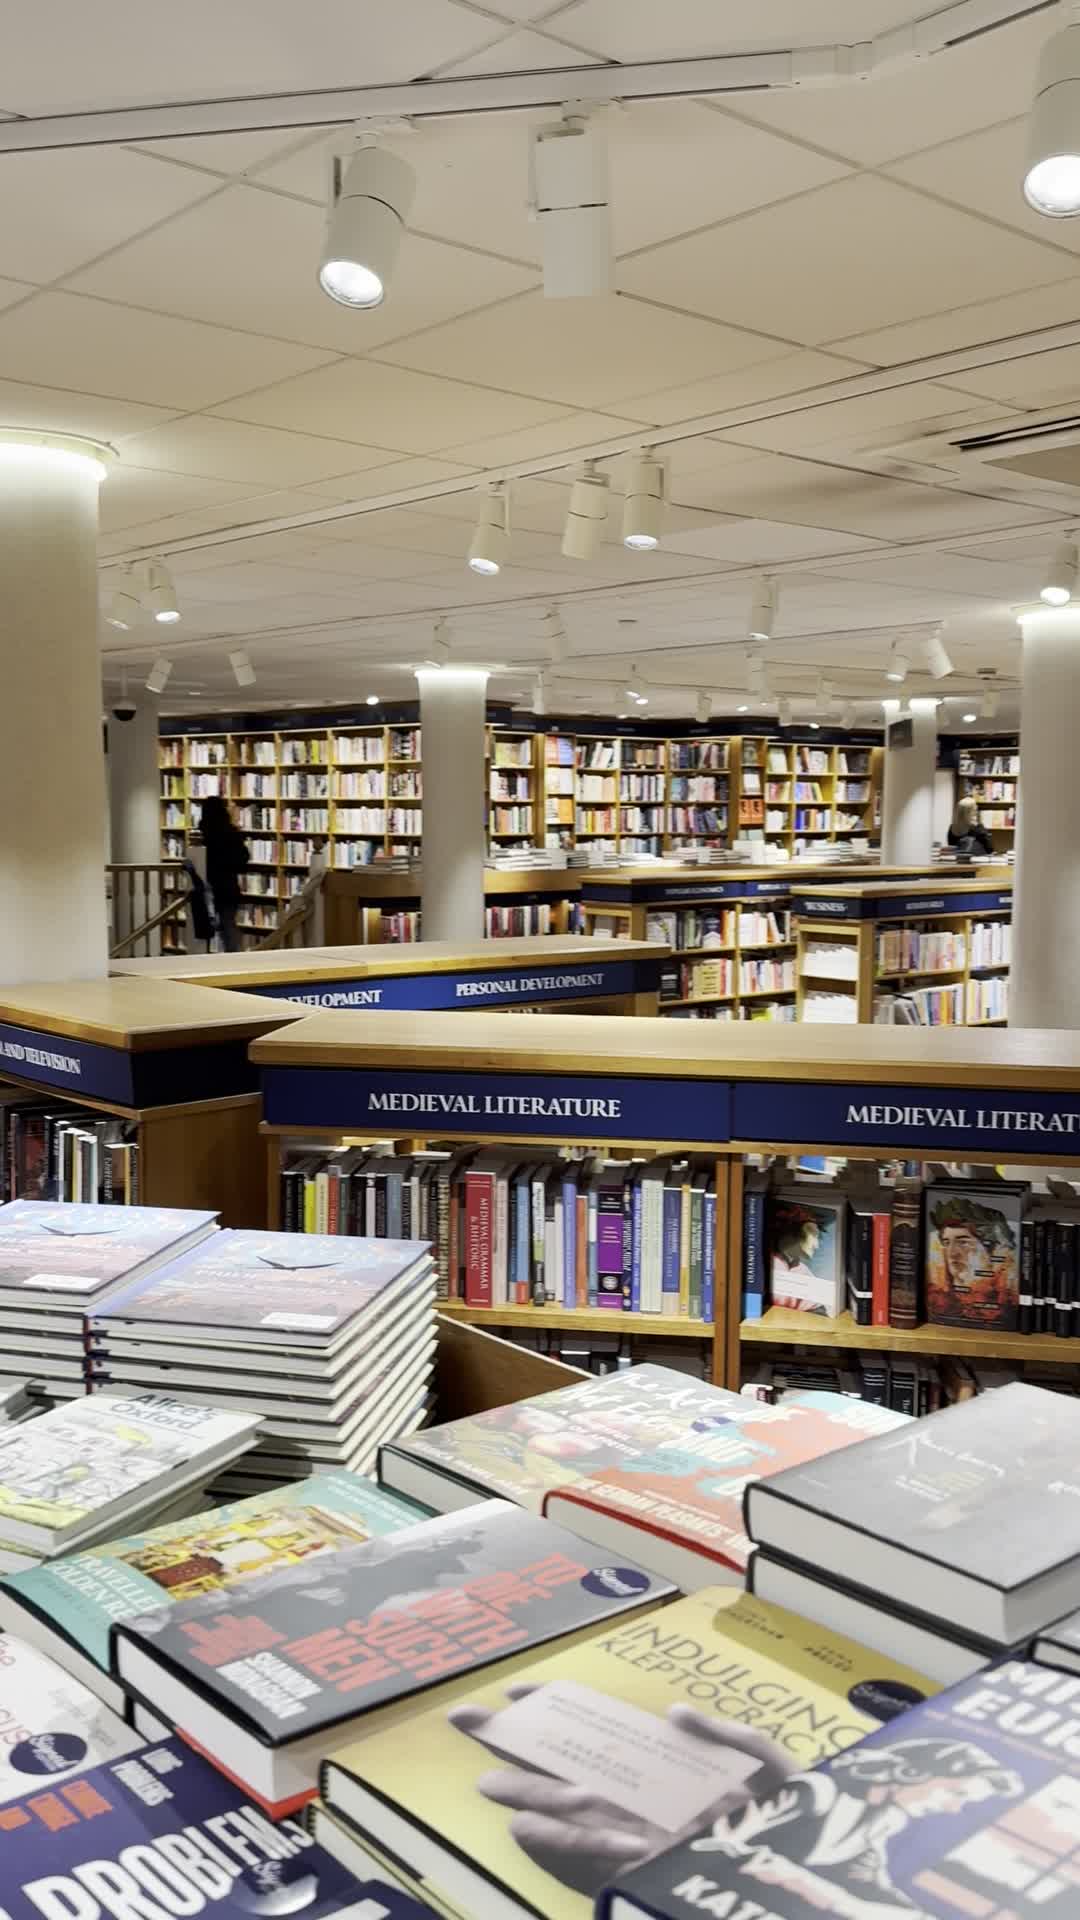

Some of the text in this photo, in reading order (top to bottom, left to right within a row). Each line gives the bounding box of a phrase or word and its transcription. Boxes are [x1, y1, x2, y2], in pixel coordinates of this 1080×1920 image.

[288, 990, 383, 1008] VELOPMENT
[456, 973, 604, 997] PERSONAL DEVELOPMENT
[24, 1046, 80, 1074] TELEVISION
[368, 1093, 621, 1118] MEDIEVAL LITERATURE
[846, 1104, 1080, 1133] MEDIEVAL LITERAT
[470, 1225, 478, 1270] RHETORIC
[480, 1198, 489, 1290] MEDIEVAL GRAMMAR
[111, 1403, 203, 1429] Oxford
[128, 1394, 218, 1420] Alice's
[519, 1552, 588, 1587] TO
[463, 1571, 553, 1614] DIE
[407, 1588, 529, 1656] WITH
[280, 1626, 401, 1692] MEN
[345, 1610, 475, 1680] SUCH
[597, 1637, 835, 1763] KLEPTOCRACY
[620, 1622, 868, 1752] INDULGING
[672, 1875, 790, 1920] KAT
